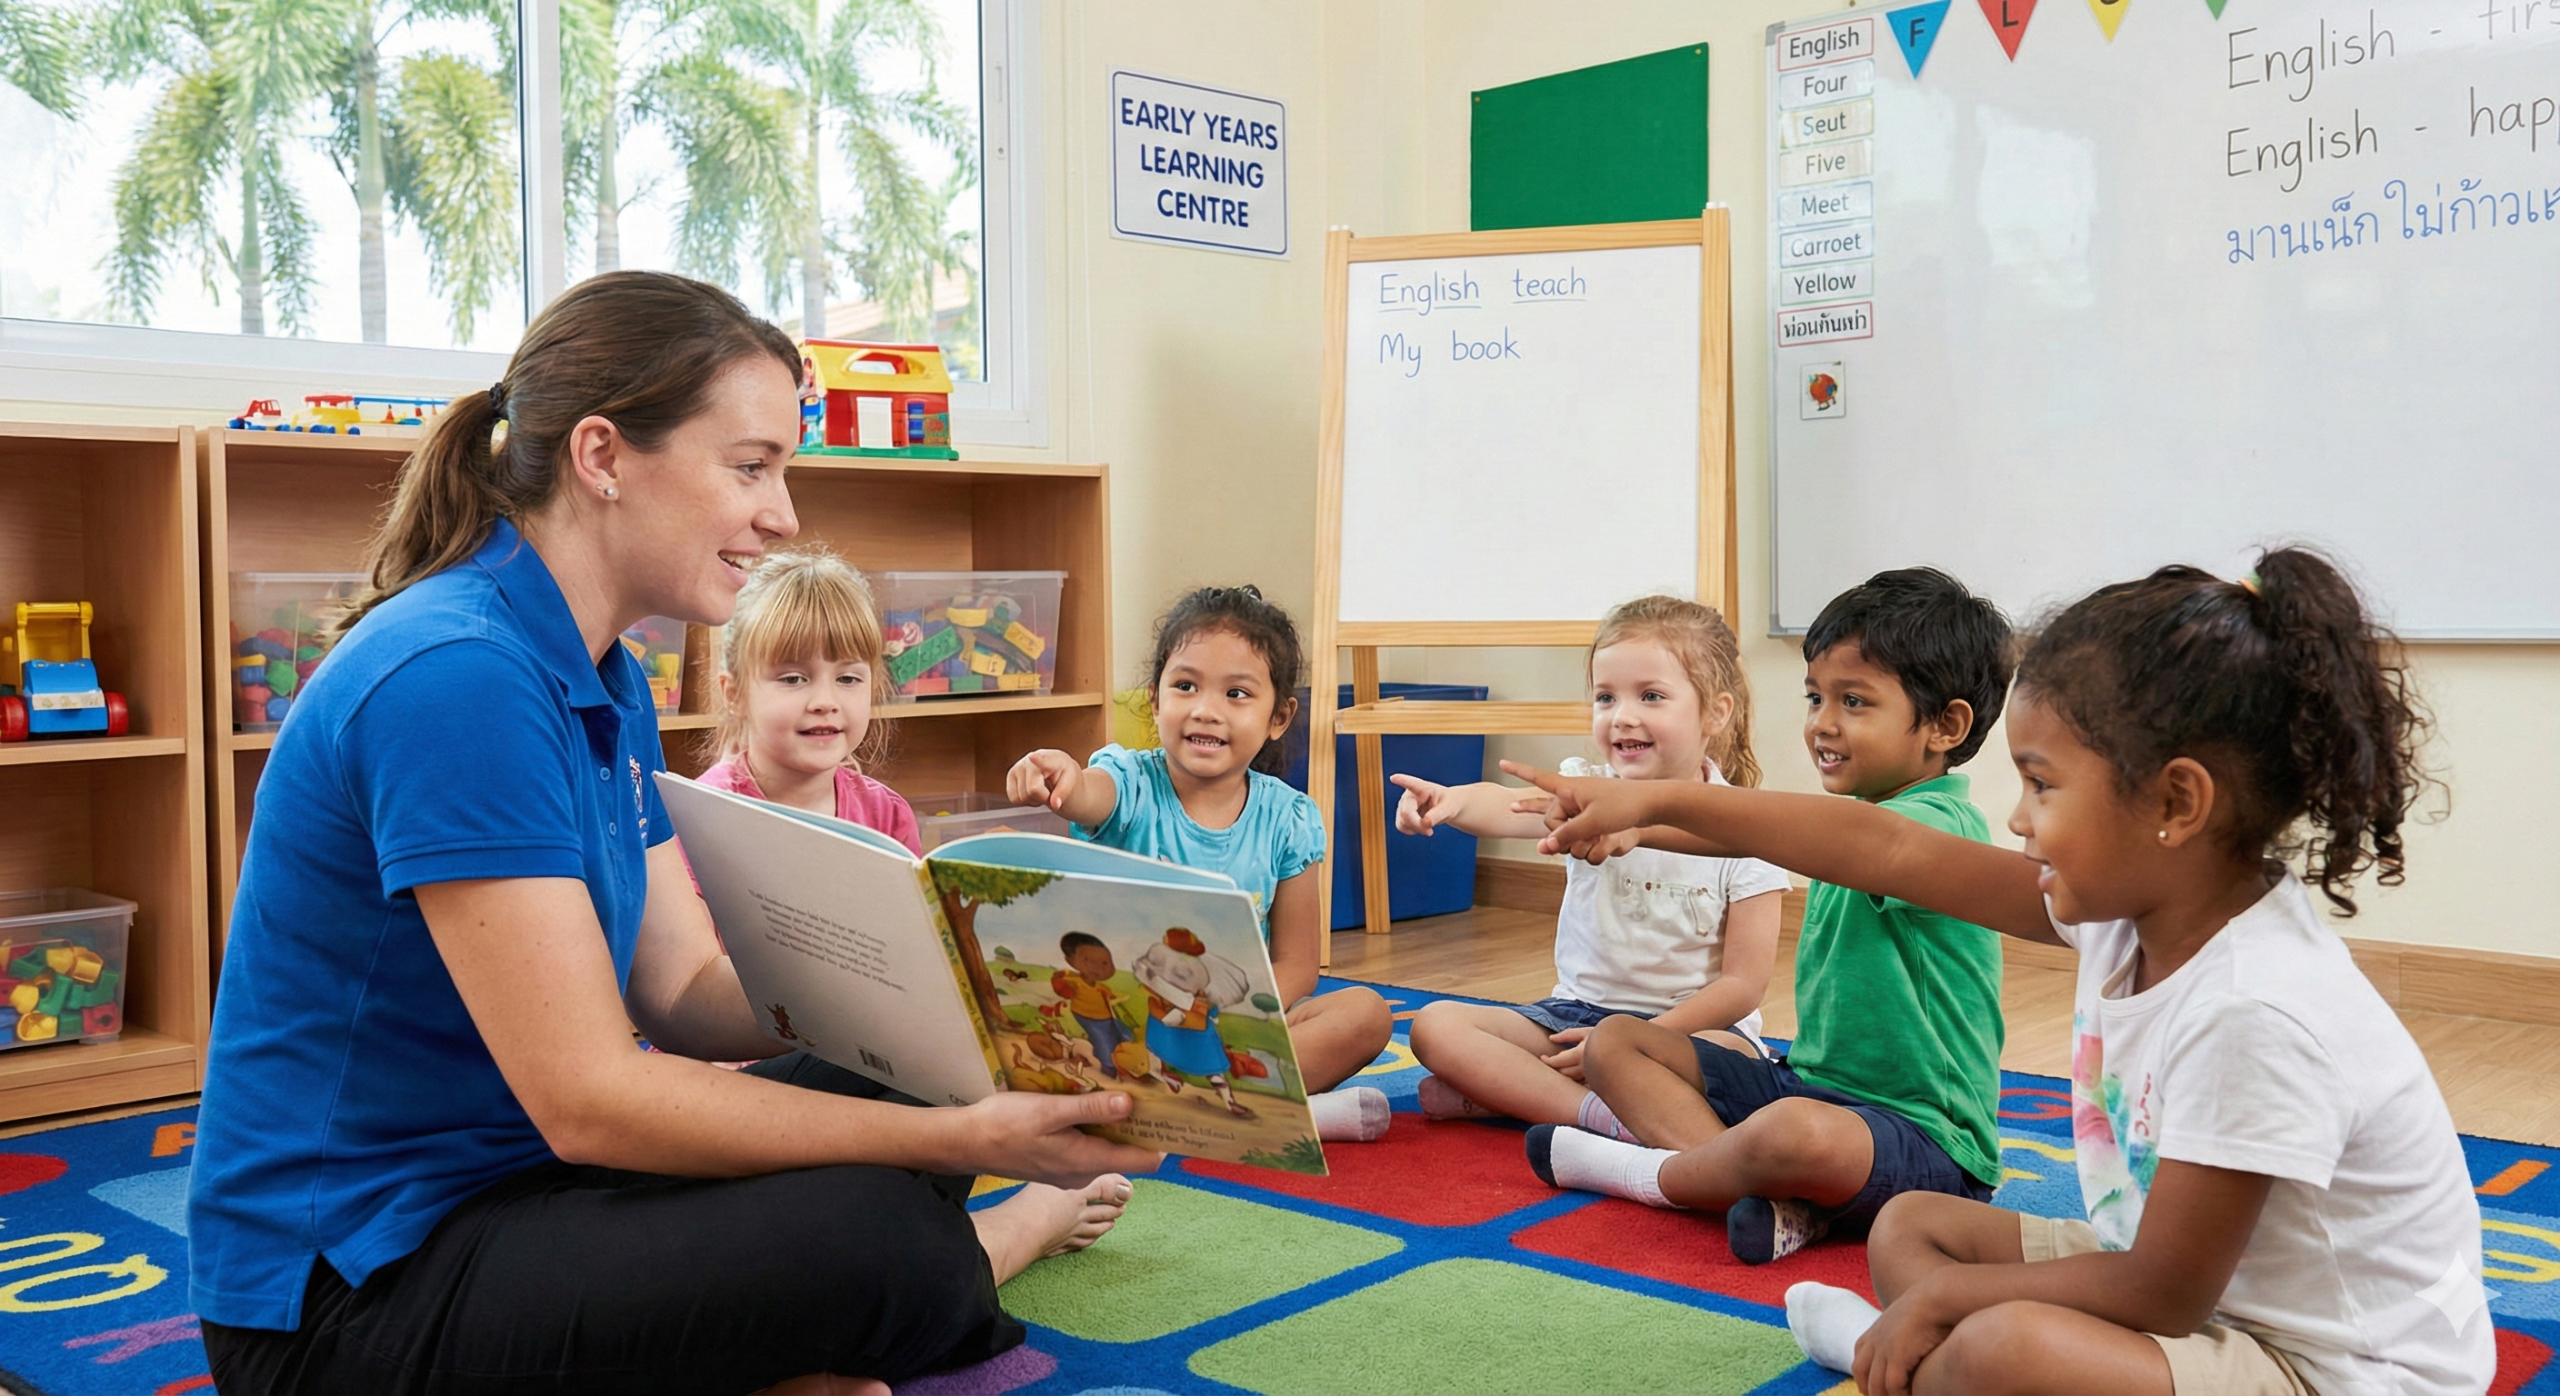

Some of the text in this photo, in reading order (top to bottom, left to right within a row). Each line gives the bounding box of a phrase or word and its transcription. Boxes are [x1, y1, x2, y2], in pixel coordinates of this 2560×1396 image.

[1789, 26, 1860, 60] English
[1909, 0, 2019, 48] F L
[2228, 8, 2395, 103] English
[1803, 75, 1848, 98] Four
[1121, 97, 1279, 151] EARLY YEARS
[1803, 111, 1848, 137] Seut
[2226, 107, 2379, 194] English
[2469, 85, 2560, 154] hap
[1140, 143, 1265, 189] LEARNING
[1805, 152, 1847, 176] Five
[1156, 188, 1250, 229] CENTRE
[1801, 193, 1850, 217] Meet
[1790, 233, 1862, 258] Carroet
[1379, 266, 1587, 317] English teach
[1793, 272, 1857, 296] Yellow
[1379, 325, 1522, 379] My book
